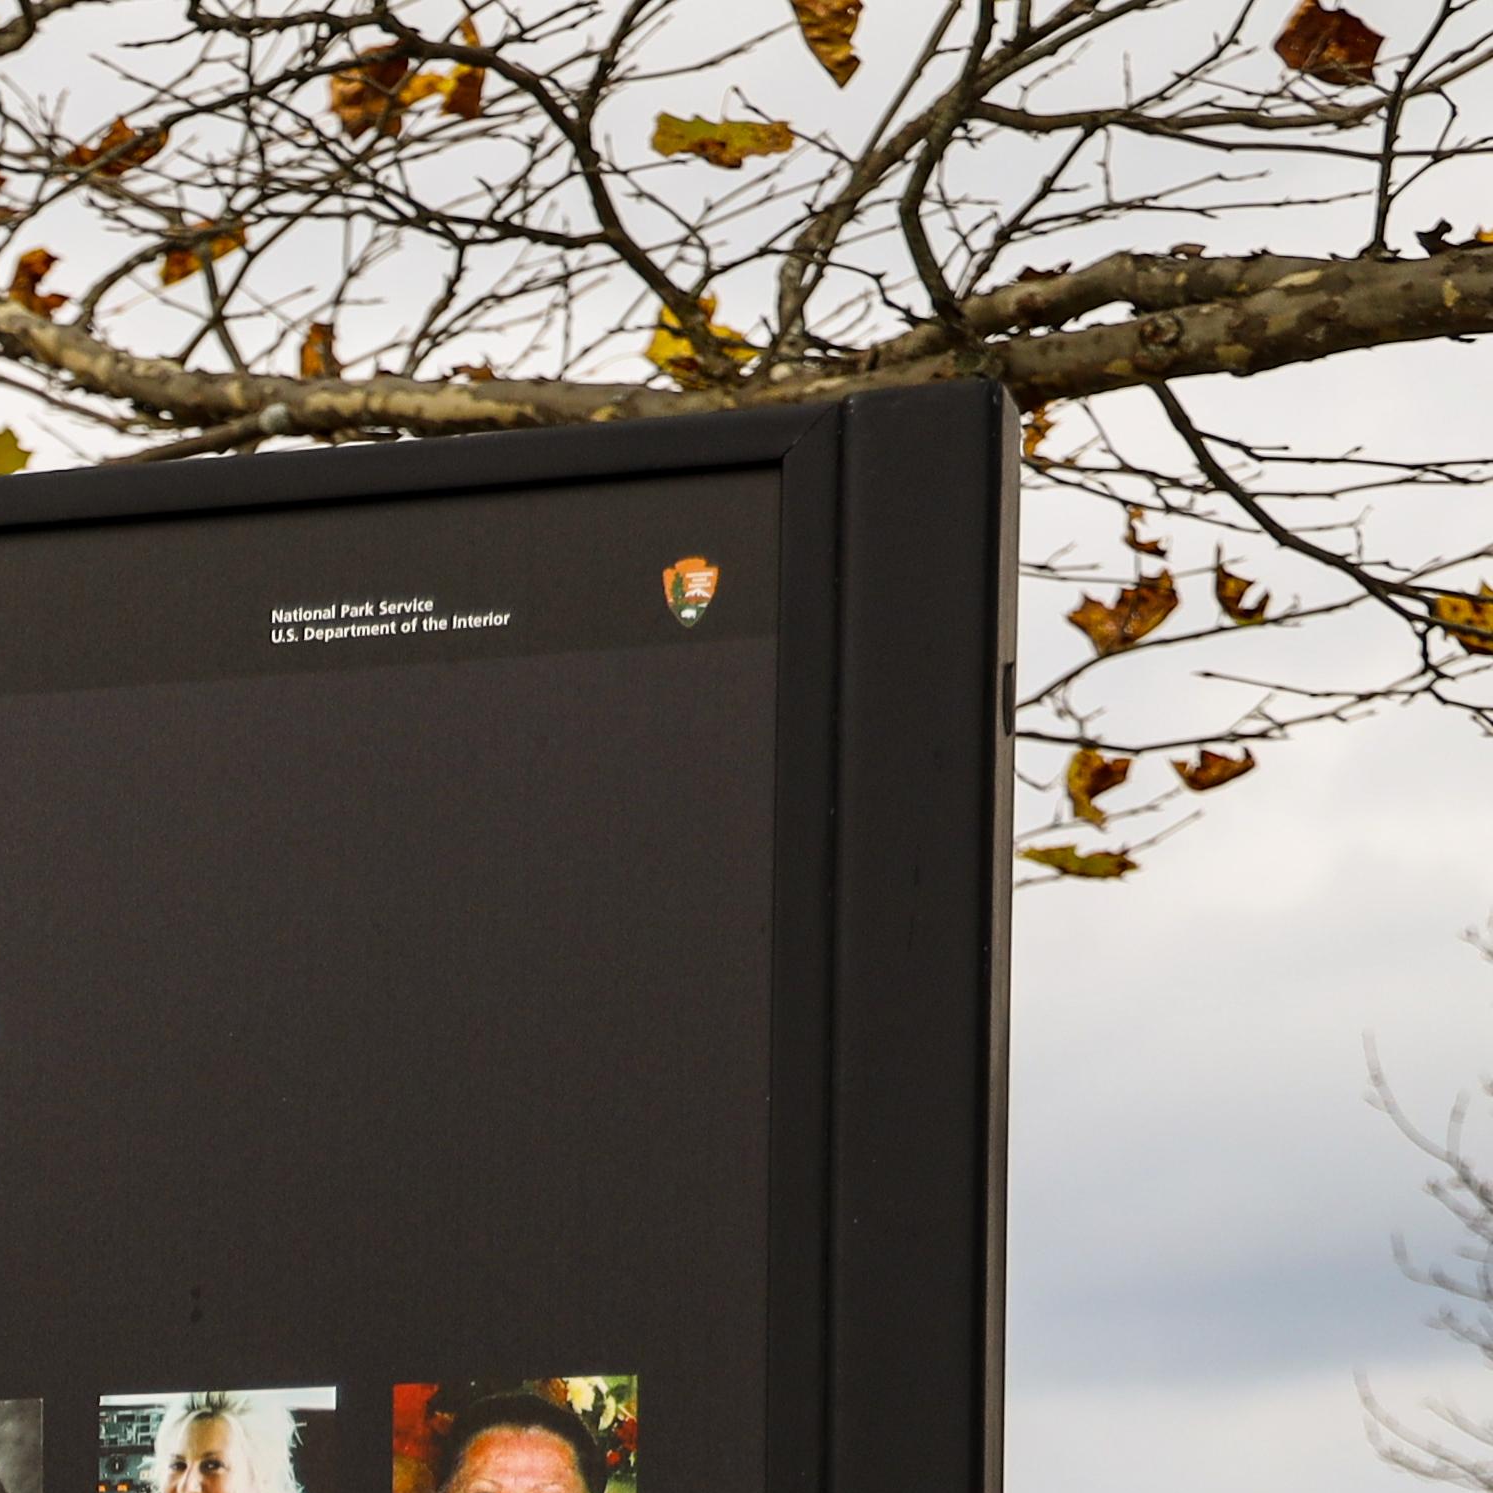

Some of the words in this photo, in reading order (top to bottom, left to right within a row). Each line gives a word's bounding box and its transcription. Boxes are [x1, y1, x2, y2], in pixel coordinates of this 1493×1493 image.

[272, 604, 335, 623] National
[341, 602, 374, 618] Park
[379, 598, 433, 615] Service
[272, 628, 298, 643] U.S.
[304, 621, 396, 642] Department
[401, 617, 417, 633] of
[423, 616, 447, 631] the
[453, 612, 510, 629] Interior
